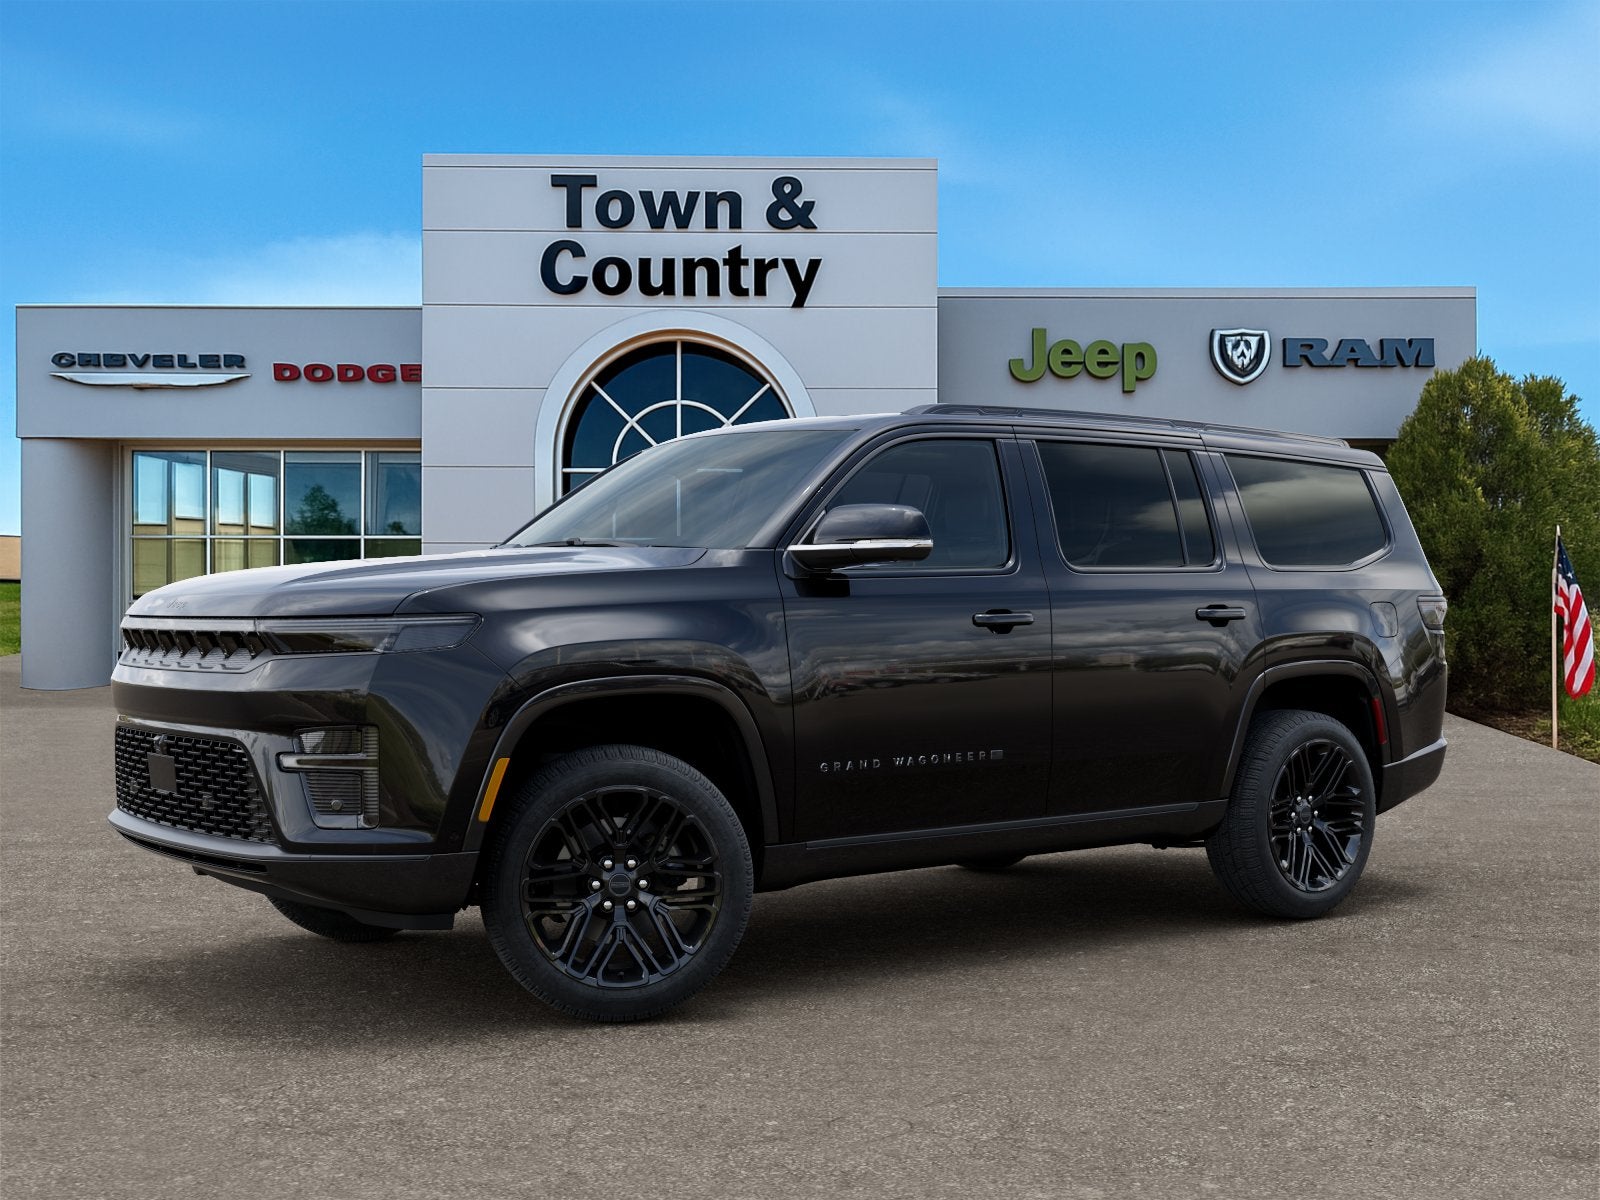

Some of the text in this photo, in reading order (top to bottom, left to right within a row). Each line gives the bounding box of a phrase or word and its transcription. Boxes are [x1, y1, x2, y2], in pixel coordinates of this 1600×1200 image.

[550, 174, 818, 230] Town &
[540, 239, 822, 308] Country
[273, 363, 422, 382] DODGE
[1009, 328, 1157, 392] Jeep
[1283, 338, 1435, 367] RAM
[820, 750, 986, 772] GRAND WAGONEER
